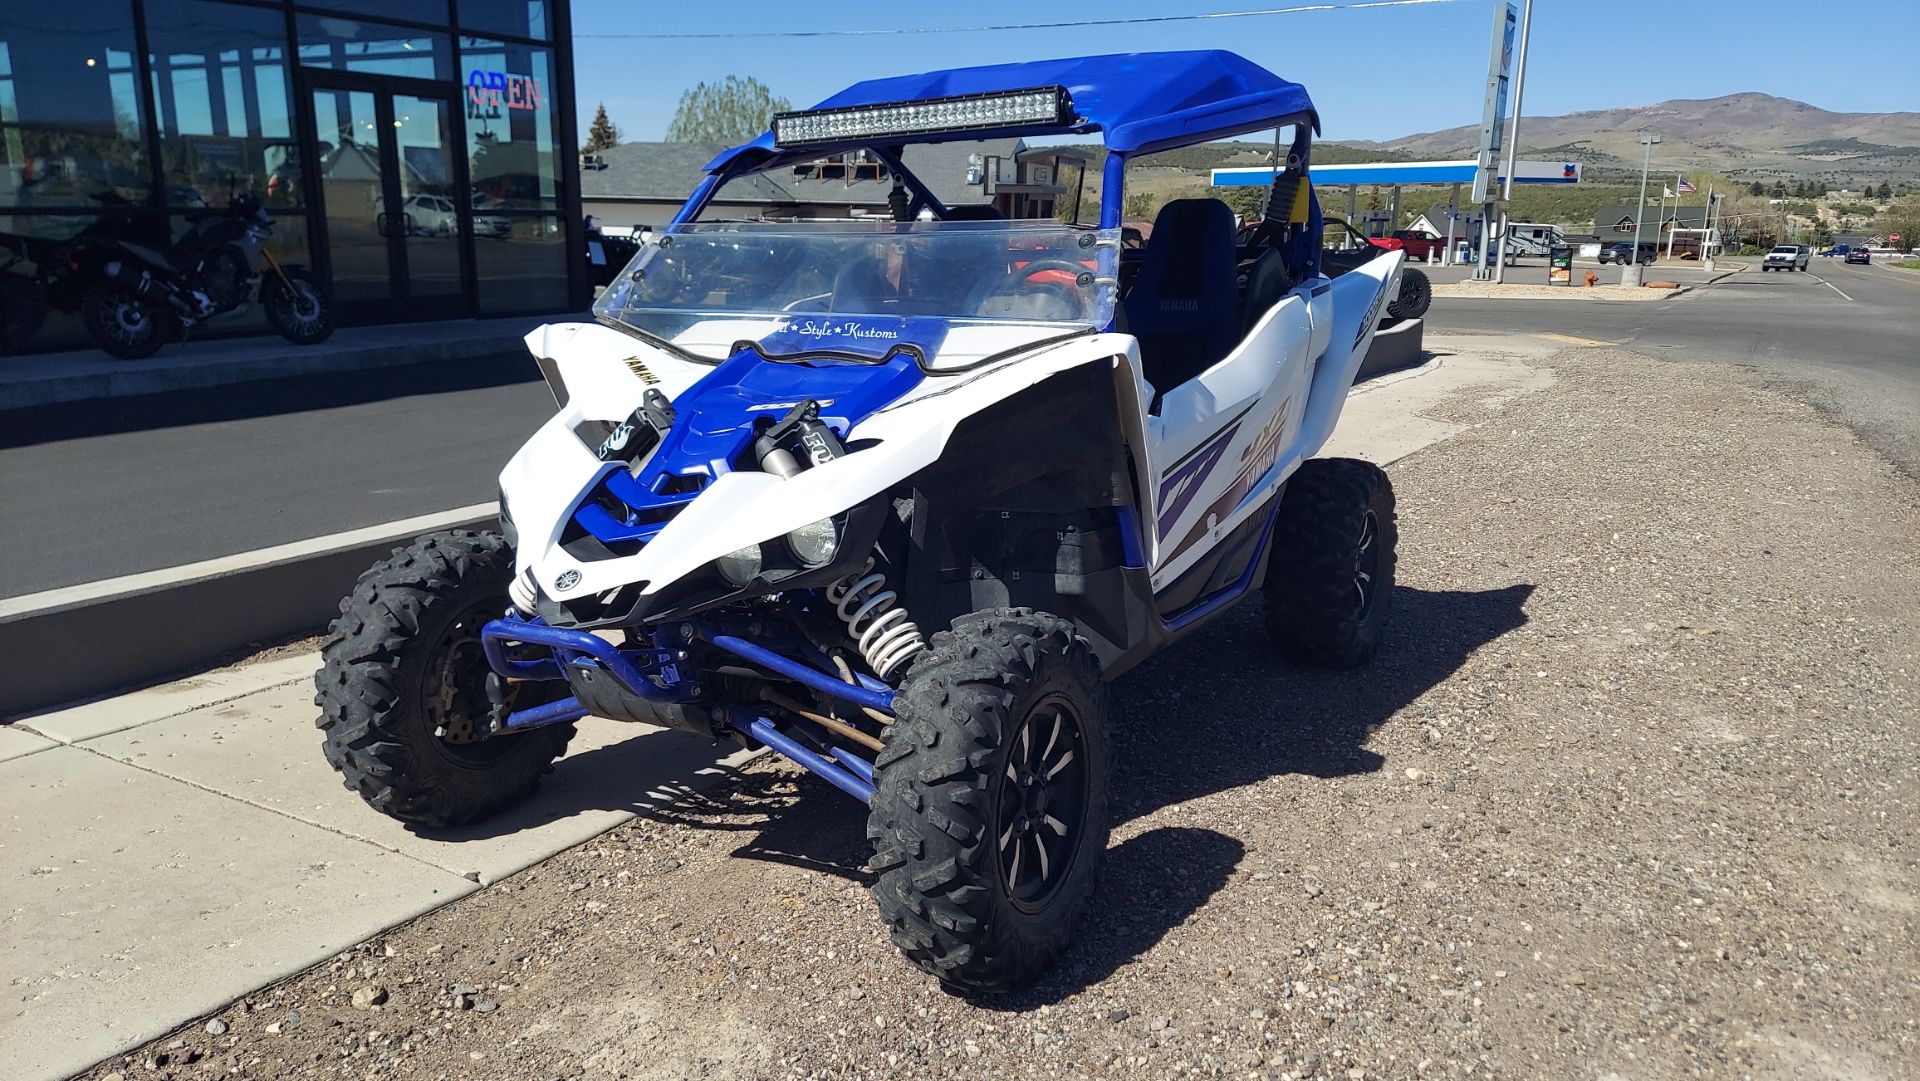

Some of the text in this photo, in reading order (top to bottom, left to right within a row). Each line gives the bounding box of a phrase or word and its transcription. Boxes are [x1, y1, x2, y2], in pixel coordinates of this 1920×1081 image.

[469, 70, 542, 111] OPEN
[1159, 299, 1199, 311] YAMAHA
[799, 320, 832, 340] Style
[842, 322, 898, 339] Kustoms
[622, 355, 661, 386] YAMAHA
[803, 431, 836, 468] FO
